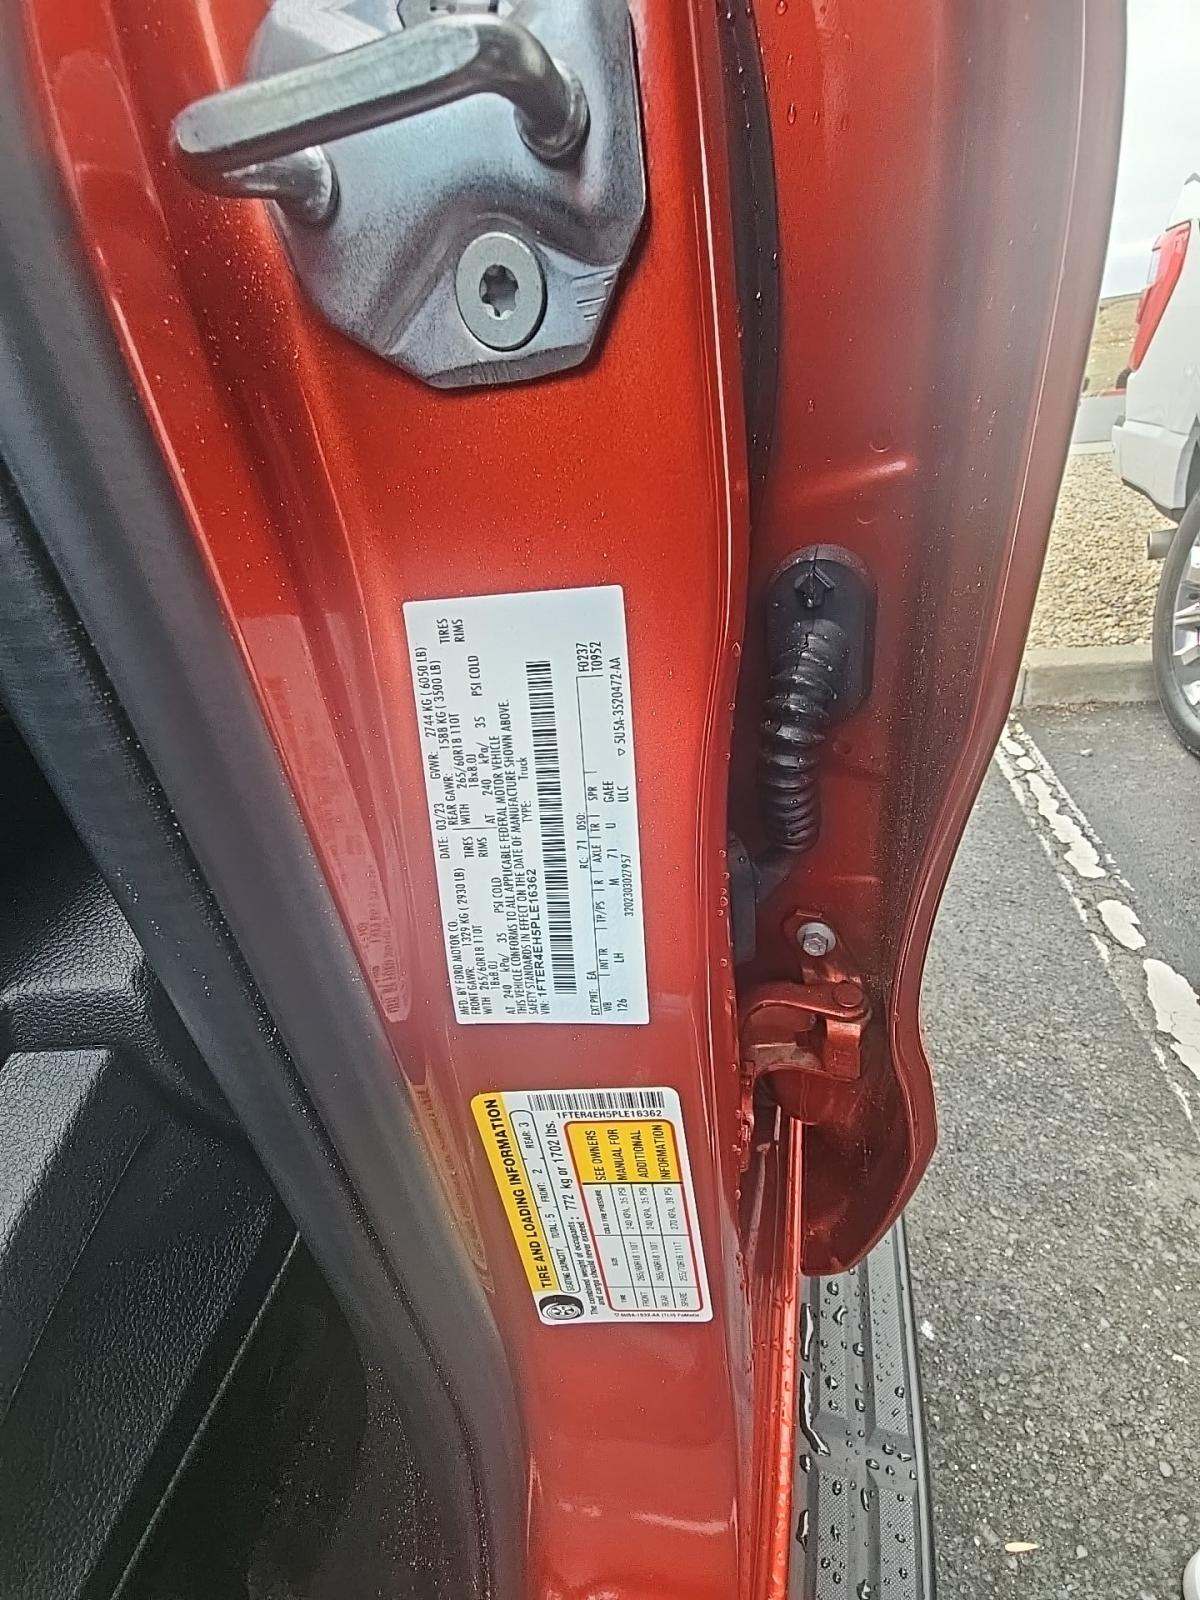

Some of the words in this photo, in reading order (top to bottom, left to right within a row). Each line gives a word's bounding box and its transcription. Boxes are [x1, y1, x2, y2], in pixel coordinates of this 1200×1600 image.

[437, 619, 450, 644] TIRES
[452, 619, 465, 642] RIMS
[415, 647, 427, 662] LB)
[576, 643, 589, 672] F0237
[590, 642, 603, 671] T0952
[429, 661, 441, 675] LB)
[468, 656, 480, 678] COLD
[471, 683, 482, 696] PSI
[421, 699, 433, 711] KG
[609, 657, 625, 743] 5U5A-3520472-AA
[436, 712, 447, 724] KG
[448, 713, 461, 734] 110T
[474, 717, 486, 728] 35
[499, 700, 512, 731] ABOVE.
[423, 715, 436, 737] 2744
[438, 727, 450, 749] 1588
[489, 736, 502, 770] VEHICLE
[502, 735, 515, 767] SHOWN
[428, 752, 441, 779] GVWR:
[451, 738, 467, 789] 265/60R18
[466, 754, 479, 788] 18x8.0J
[516, 757, 528, 780] Truck
[443, 774, 455, 801] GAWR:
[481, 779, 493, 795] 240
[493, 773, 506, 803] MOTOR
[587, 787, 598, 801] SPR
[602, 781, 614, 802] GAEE
[617, 786, 629, 802] ULC
[505, 771, 521, 832] MANUFACTURE
[434, 803, 446, 830] 03/23
[447, 804, 458, 825] REAR
[459, 804, 470, 825] WITH
[485, 815, 495, 823] AT
[521, 801, 533, 822] TYPE:
[496, 807, 509, 841] FEDERAL
[576, 813, 586, 830] DSO:
[590, 823, 600, 831] TR
[438, 837, 450, 859] DATE:
[463, 836, 474, 858] TIRES
[477, 837, 488, 857] RIMS
[511, 836, 522, 846] OF
[576, 841, 587, 850] 71
[512, 849, 524, 869] DATE
[591, 845, 602, 862] AXLE
[607, 849, 618, 858] 71
[454, 868, 465, 881] LB)
[500, 845, 514, 892] APPLICABLE
[491, 877, 503, 898] COLD
[515, 872, 525, 887] THE
[621, 854, 634, 916] 3202303027957
[505, 895, 516, 908] ALL
[516, 890, 527, 901] ON
[493, 901, 504, 913] PSI
[507, 911, 517, 921] TO
[595, 901, 606, 922] TP/PS
[448, 919, 458, 932] CO.
[459, 913, 469, 924] KG
[517, 905, 529, 930] EFFECT
[461, 927, 472, 946] 1329
[472, 925, 483, 943] 110T
[497, 933, 507, 943] 35
[526, 869, 547, 997] 1FTER4EH5PLE16362
[450, 934, 462, 962] MOTOR
[507, 924, 521, 966] CONFORMS
[599, 948, 608, 956] TR
[521, 945, 535, 989] STANDARDS
[599, 959, 608, 969] INT
[614, 953, 624, 963] LH
[454, 965, 465, 983] FORD
[475, 947, 489, 990] 265/60R18
[488, 961, 500, 989] 18x8.0J
[587, 971, 597, 980] EA
[466, 967, 477, 990] GAWR:
[513, 969, 524, 998] VEHICLE
[503, 985, 513, 998] 240
[589, 989, 598, 1003] PNT:
[459, 998, 470, 1015] MFD.
[470, 993, 481, 1014] FRONT
[482, 997, 492, 1014] WITH
[517, 1000, 527, 1014] THIS
[527, 991, 539, 1014] SAFETY
[540, 1001, 550, 1015] VIN:
[590, 1005, 600, 1015] EXT
[603, 1002, 612, 1011] WB
[617, 999, 628, 1011] 126
[557, 1110, 662, 1119] 1FTER4EH5PLE16362
[545, 1121, 558, 1137] lbs.
[607, 1129, 620, 1145] FOR
[484, 1099, 522, 1185] INFORMATION
[522, 1131, 534, 1148] REAR:
[585, 1131, 602, 1164] OWNERS
[548, 1140, 564, 1163] 1702
[630, 1130, 649, 1177] ADDITIONAL
[652, 1125, 671, 1180] INFORMATION
[558, 1167, 568, 1175] or
[612, 1147, 627, 1180] MANUAL
[594, 1167, 606, 1180] SEE
[537, 1183, 550, 1202] FRONT:
[560, 1179, 573, 1188] kg
[618, 1187, 627, 1196] PSI
[639, 1187, 647, 1196] PSI
[562, 1195, 577, 1210] 772
[513, 1189, 537, 1237] LOADING
[568, 1222, 581, 1251] occupants
[529, 1241, 545, 1261] AND
[556, 1248, 569, 1271] CAPACITY
[584, 1243, 592, 1258] never
[536, 1265, 552, 1288] TIRE
[577, 1260, 588, 1277] weight
[587, 1261, 598, 1278] should
[582, 1279, 595, 1304] combined
[593, 1280, 602, 1294] cargo
[597, 1296, 605, 1305] and
[590, 1306, 598, 1315] The
